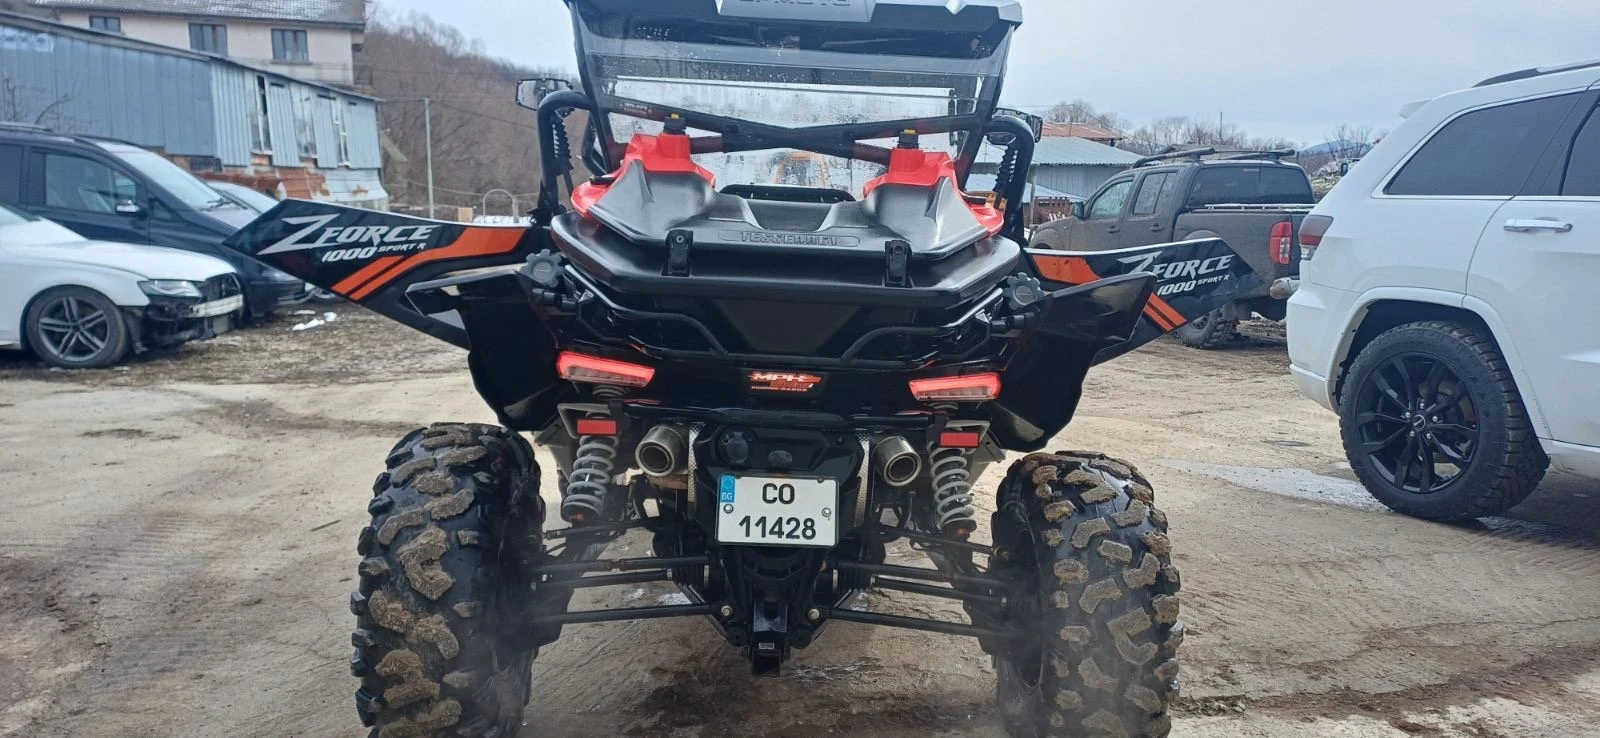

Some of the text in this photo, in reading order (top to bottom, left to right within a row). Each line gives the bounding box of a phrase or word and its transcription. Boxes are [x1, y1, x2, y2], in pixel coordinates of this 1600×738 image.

[740, 231, 838, 246] TESSERACT
[321, 242, 426, 262] 1000 SPORT R
[1157, 280, 1197, 296] 1000
[1197, 276, 1222, 285] SPORT
[721, 492, 733, 500] BG
[762, 483, 795, 505] CO
[738, 515, 816, 540] 11428
